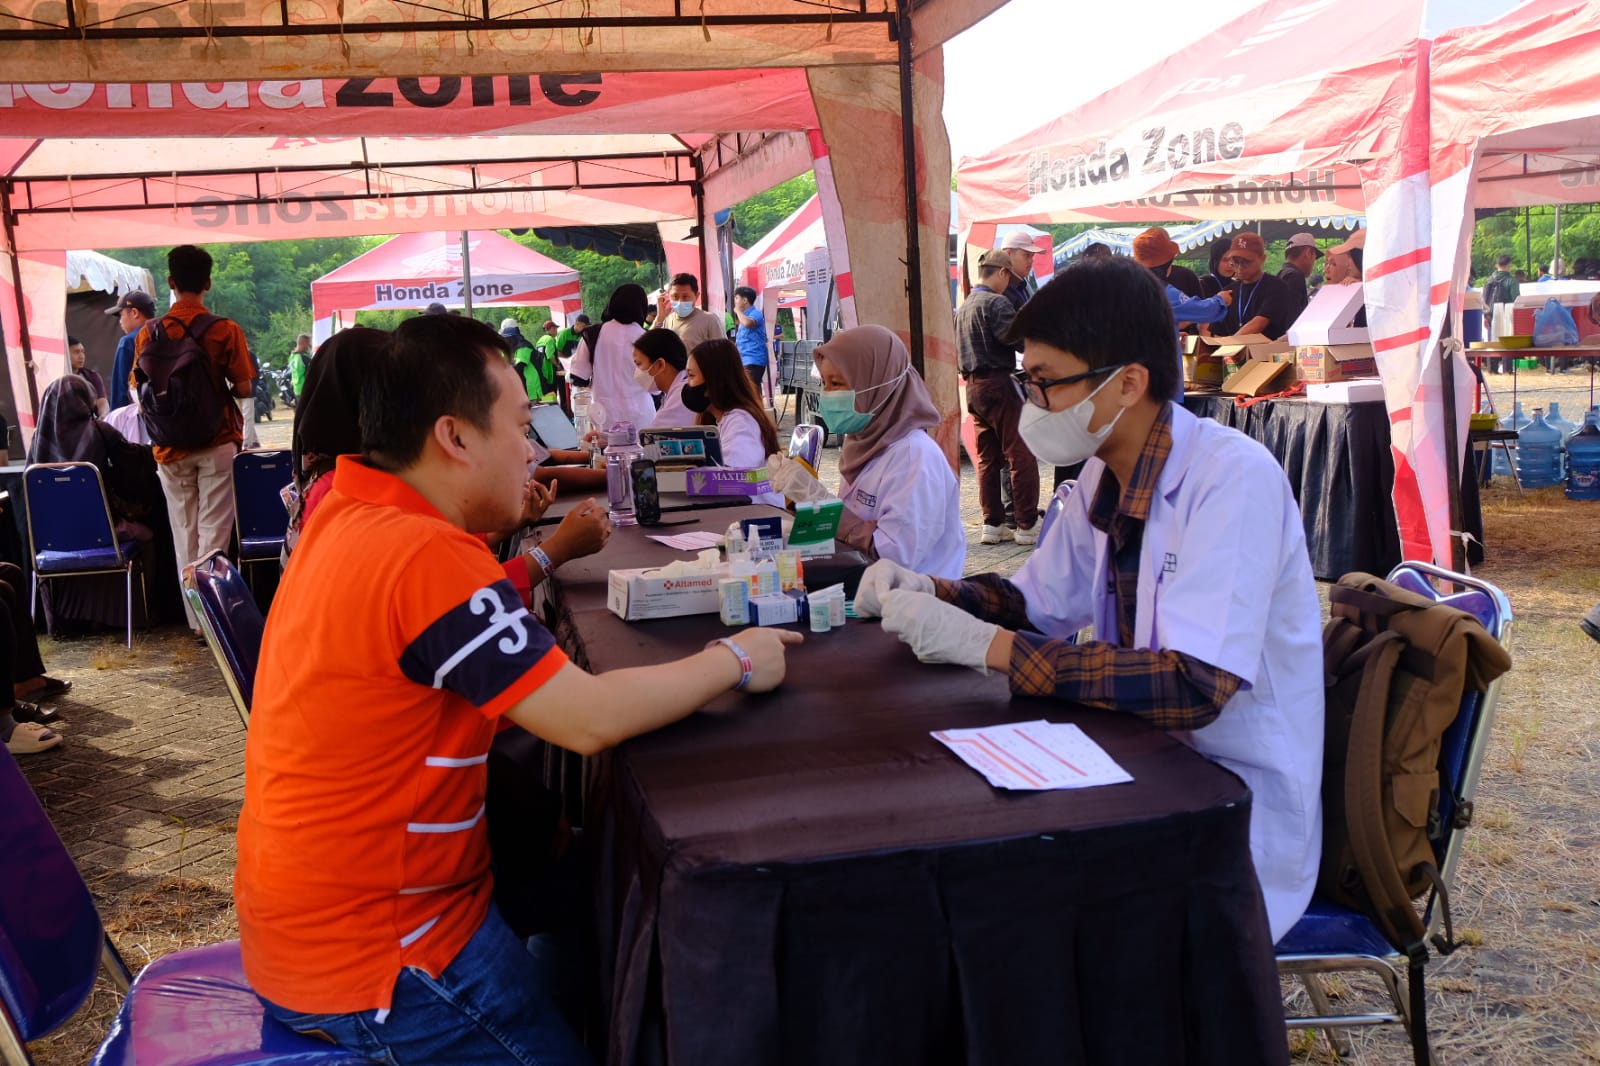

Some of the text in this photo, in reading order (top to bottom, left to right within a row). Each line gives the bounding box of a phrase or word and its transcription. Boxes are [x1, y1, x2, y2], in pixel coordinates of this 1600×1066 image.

[0, 79, 326, 109] ona
[1027, 121, 1245, 198] Honda Zone
[376, 282, 449, 301] Honda
[712, 472, 753, 481] MAXTER
[675, 578, 713, 588] Altamed
